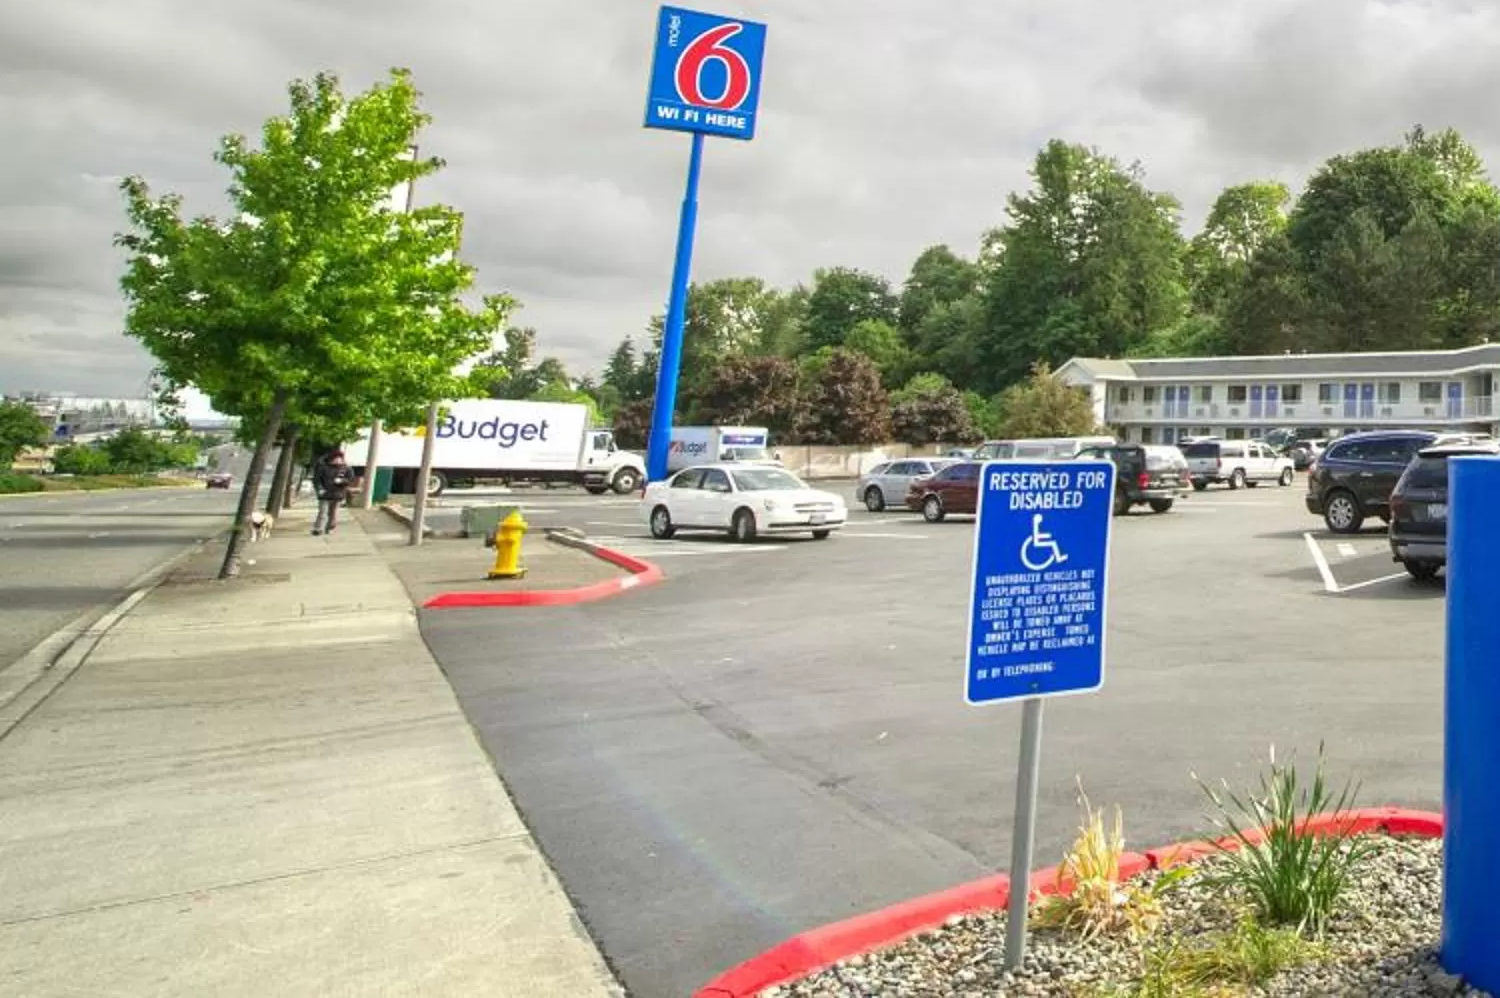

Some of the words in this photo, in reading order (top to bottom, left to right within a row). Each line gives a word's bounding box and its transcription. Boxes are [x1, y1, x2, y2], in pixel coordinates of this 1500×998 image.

[668, 14, 681, 47] motel
[674, 22, 751, 110] 6
[657, 105, 679, 119] WI
[684, 109, 699, 123] FI
[705, 113, 746, 129] HERE
[436, 414, 549, 448] Budget
[989, 472, 1070, 491] RESERVED
[1076, 471, 1106, 489] FOR
[1009, 491, 1084, 510] DISABLED
